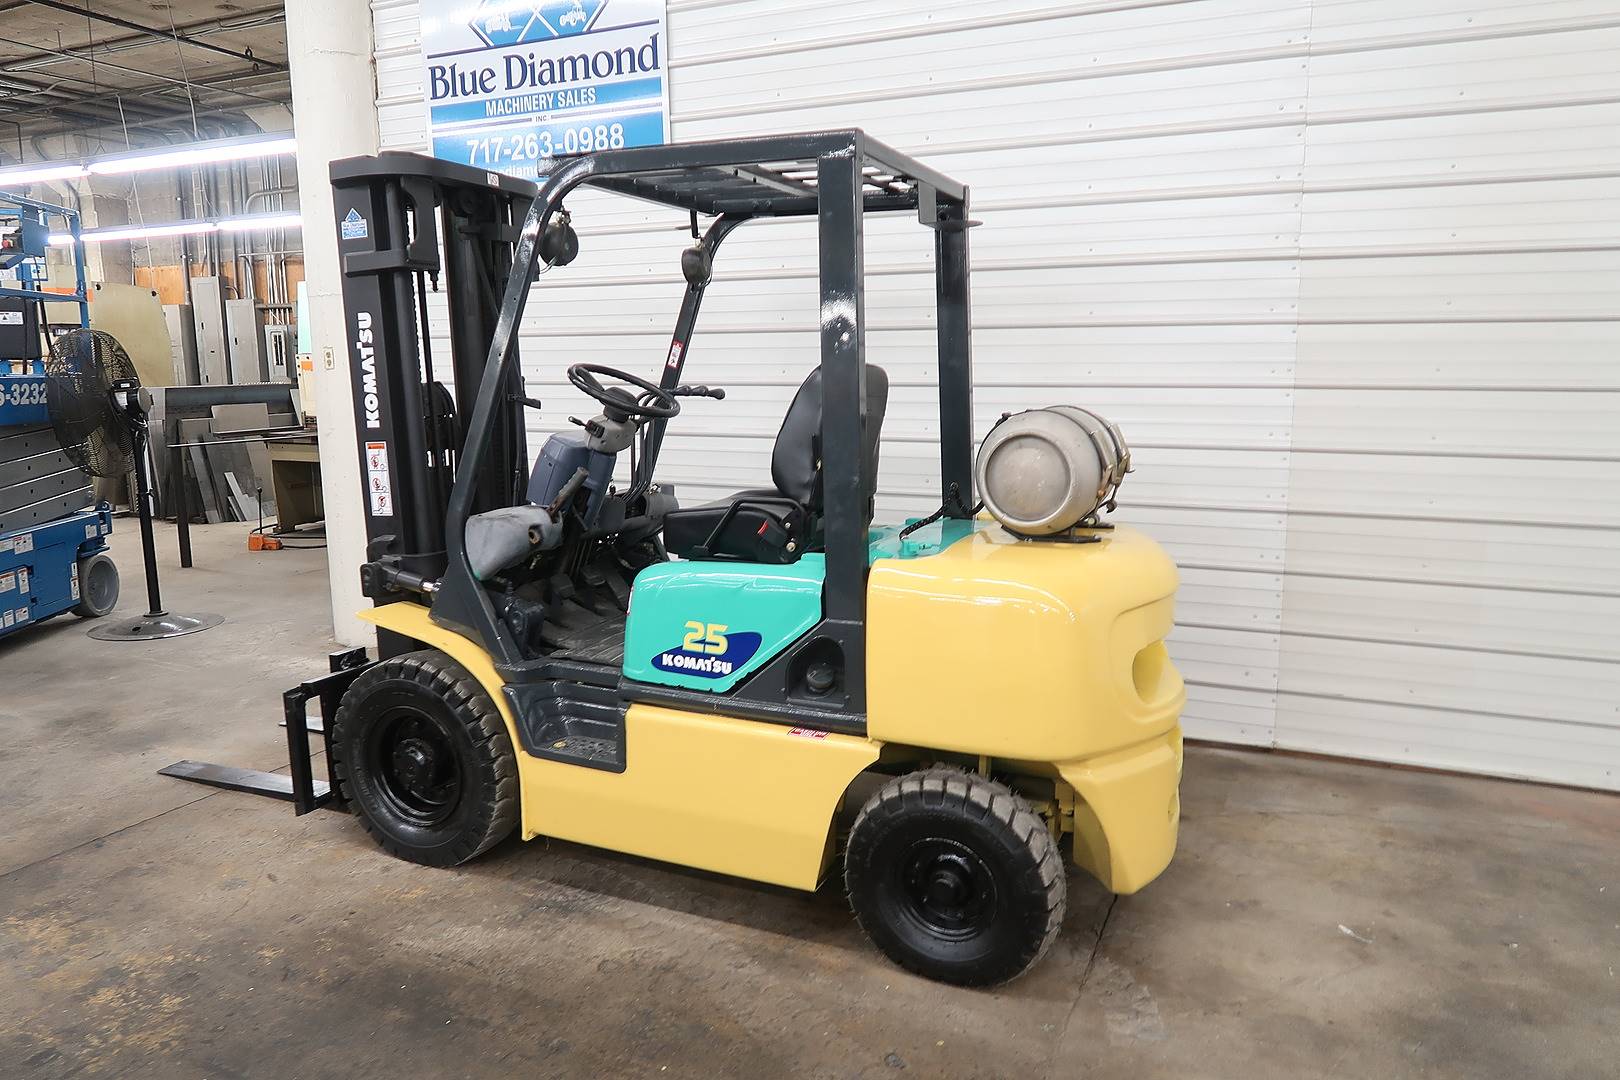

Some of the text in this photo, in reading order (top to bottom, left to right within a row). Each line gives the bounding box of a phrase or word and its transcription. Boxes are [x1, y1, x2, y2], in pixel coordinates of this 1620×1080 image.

[428, 32, 660, 100] Blue Diamond
[485, 88, 596, 116] MACHINERY SALES
[466, 123, 625, 164] 717-263-0988
[356, 312, 380, 428] KOMATSU
[683, 620, 729, 656] 25
[661, 653, 733, 675] KOMATSU
